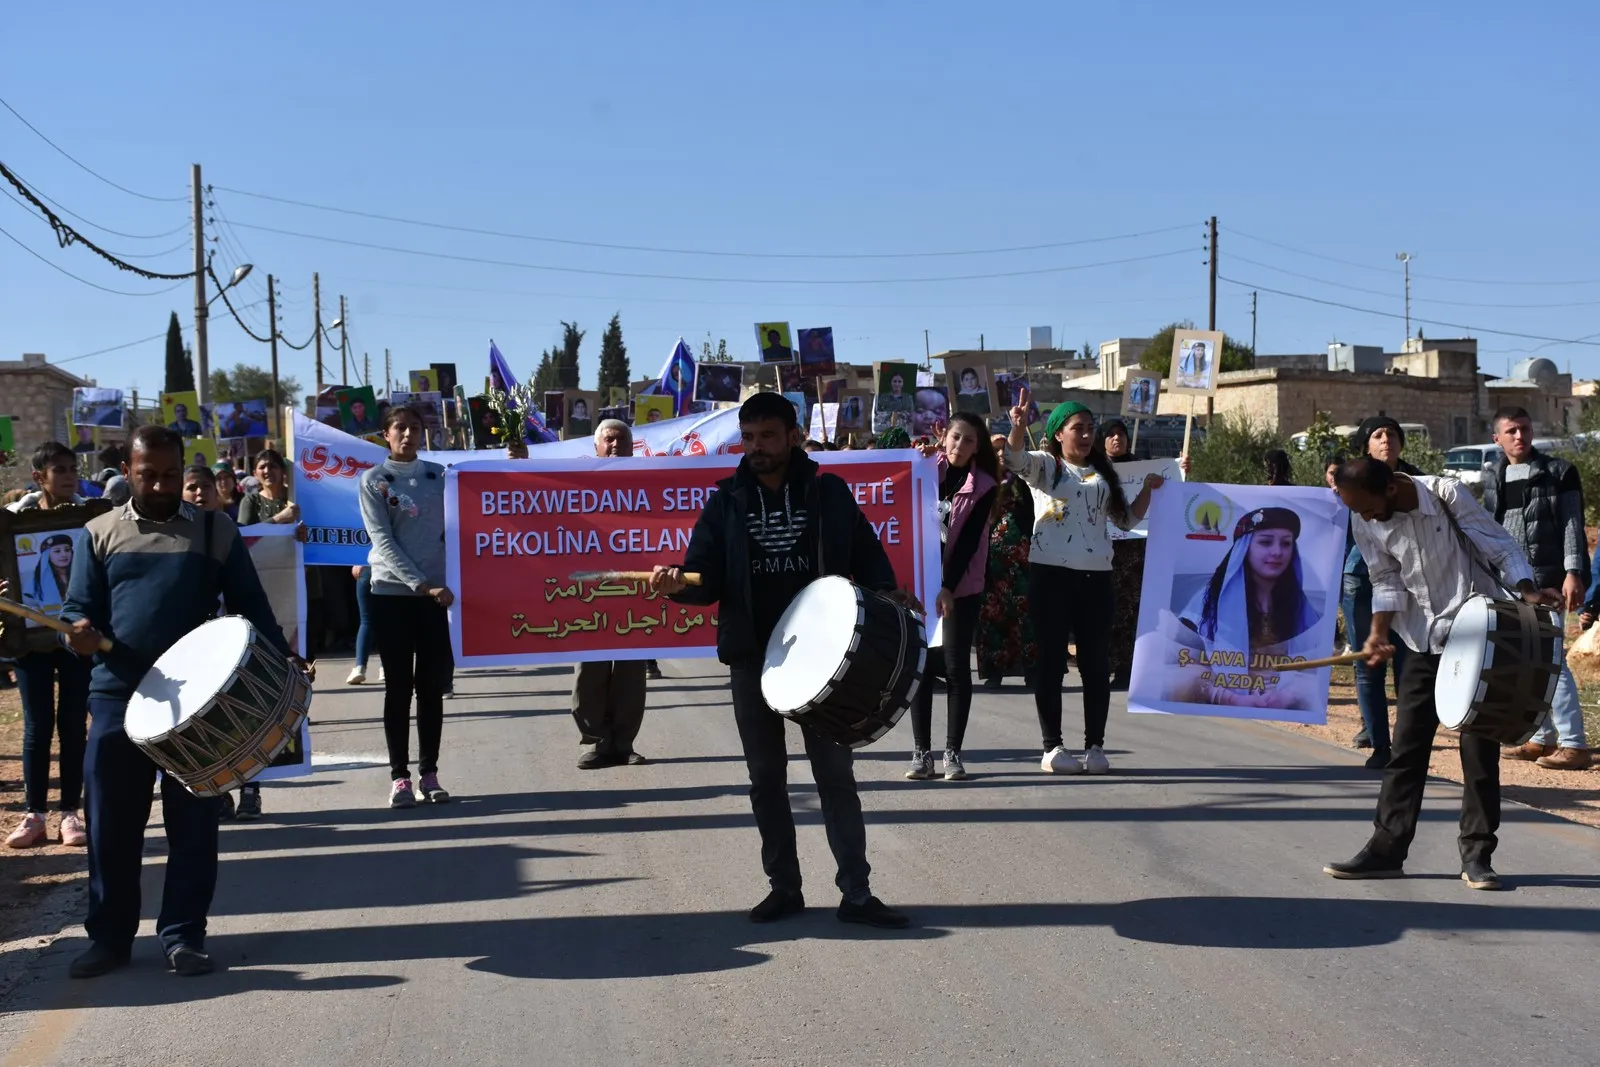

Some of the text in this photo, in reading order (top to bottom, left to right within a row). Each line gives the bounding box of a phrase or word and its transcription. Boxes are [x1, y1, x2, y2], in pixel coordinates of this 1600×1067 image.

[481, 488, 652, 516] BERXWEDANA
[847, 477, 895, 505] ETÊ
[475, 526, 603, 556] PÊKOLÎNA
[608, 527, 693, 553] GELAN
[511, 610, 608, 639] الحرية
[614, 602, 668, 636] أجل
[673, 607, 704, 634] من
[1199, 649, 1246, 668] LAVA
